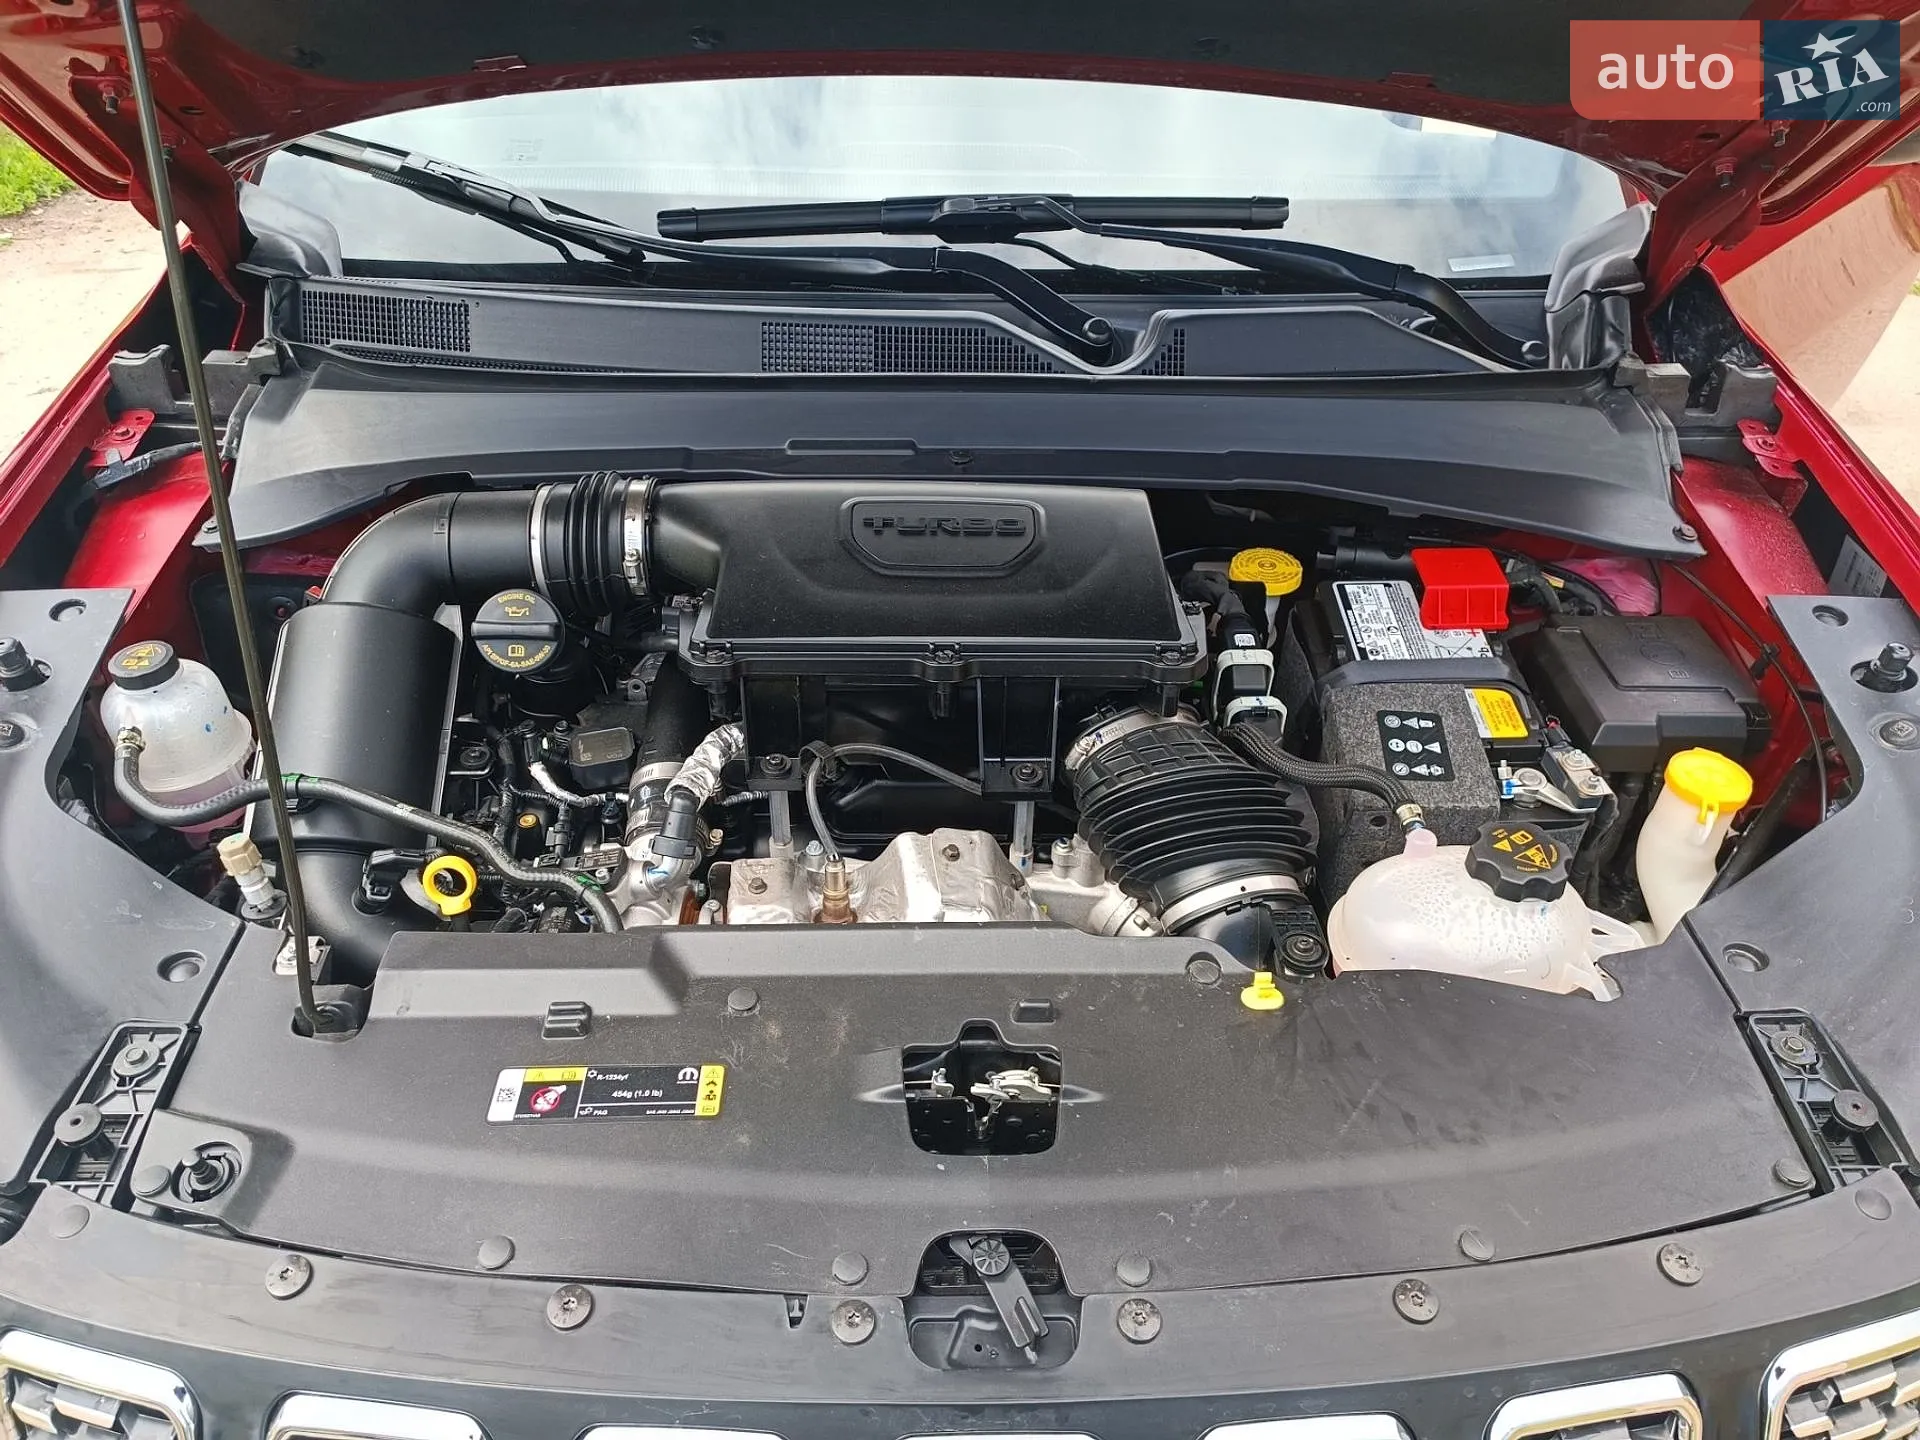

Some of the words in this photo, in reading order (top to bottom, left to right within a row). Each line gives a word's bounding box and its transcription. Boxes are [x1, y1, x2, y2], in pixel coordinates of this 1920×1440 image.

[863, 516, 1027, 536] TURBO
[497, 593, 524, 604] ENGINE
[524, 594, 536, 604] OIL
[597, 1073, 629, 1082] R-1234yf
[611, 1090, 633, 1099] 454g
[634, 1089, 651, 1099] (1.0
[651, 1089, 664, 1098] lb)
